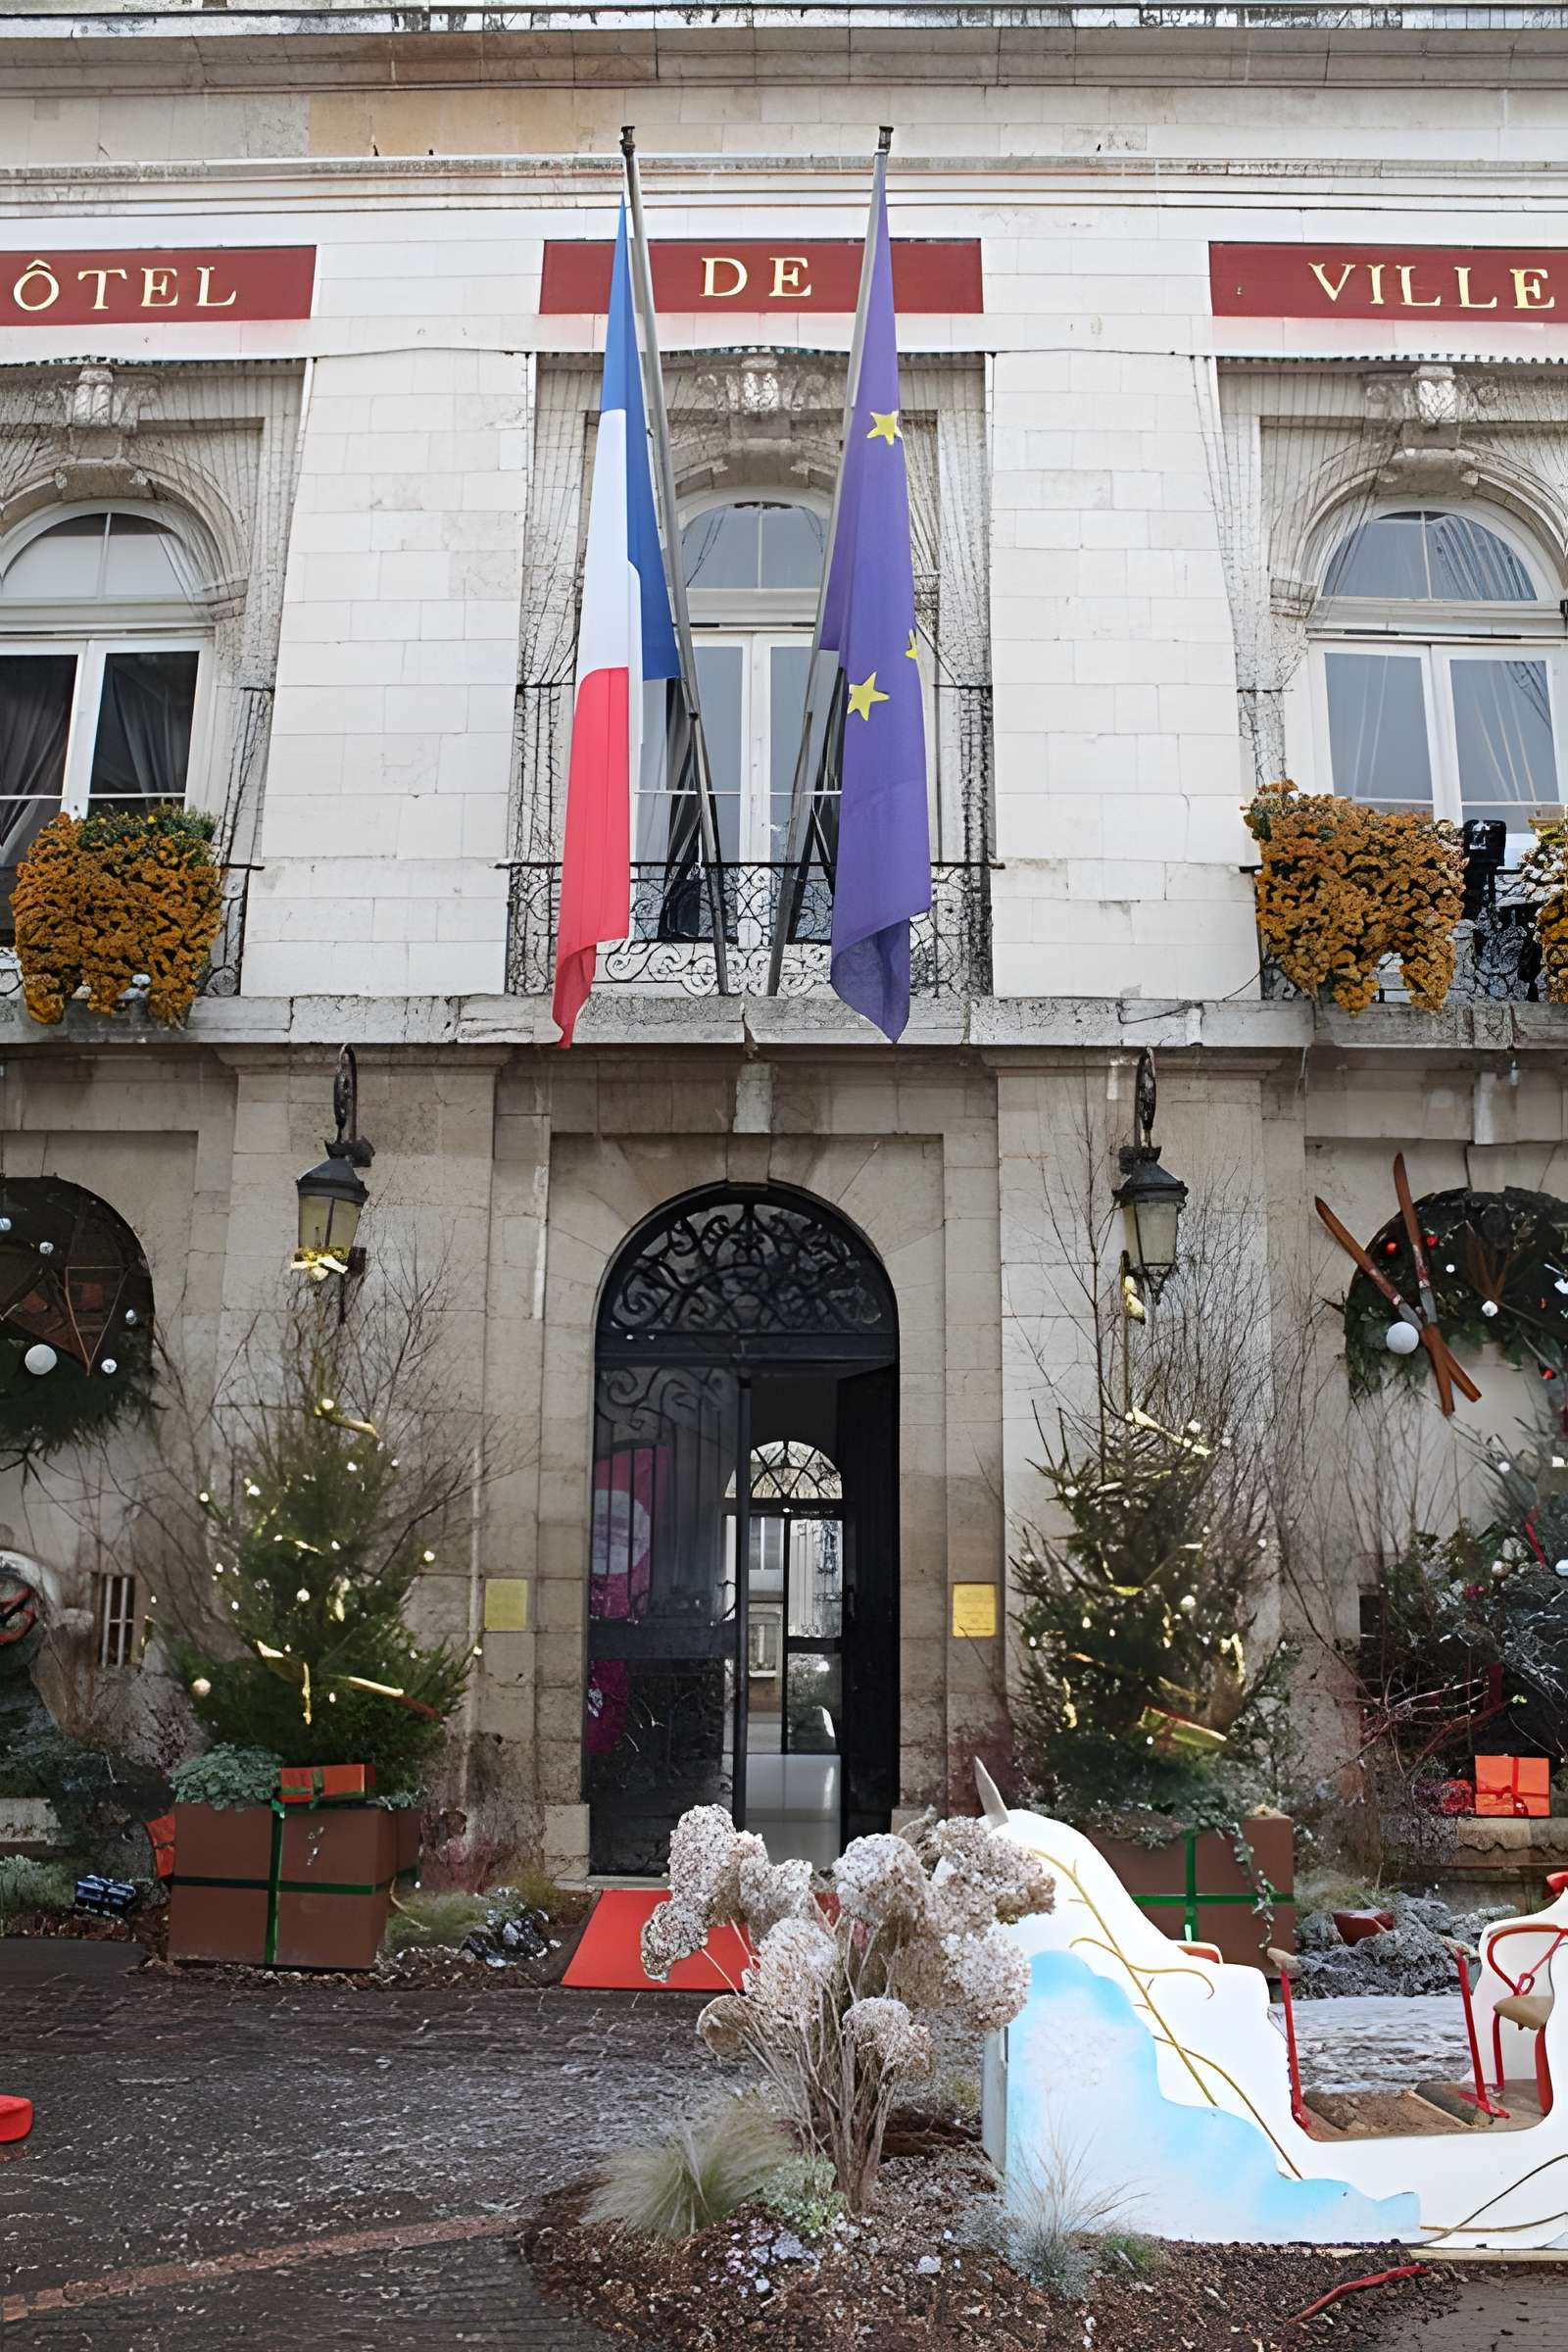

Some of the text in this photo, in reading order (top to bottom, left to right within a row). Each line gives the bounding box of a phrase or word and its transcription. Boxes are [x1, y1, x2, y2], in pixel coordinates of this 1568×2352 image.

[13, 257, 1555, 311] ÔTEL DE VILLE
